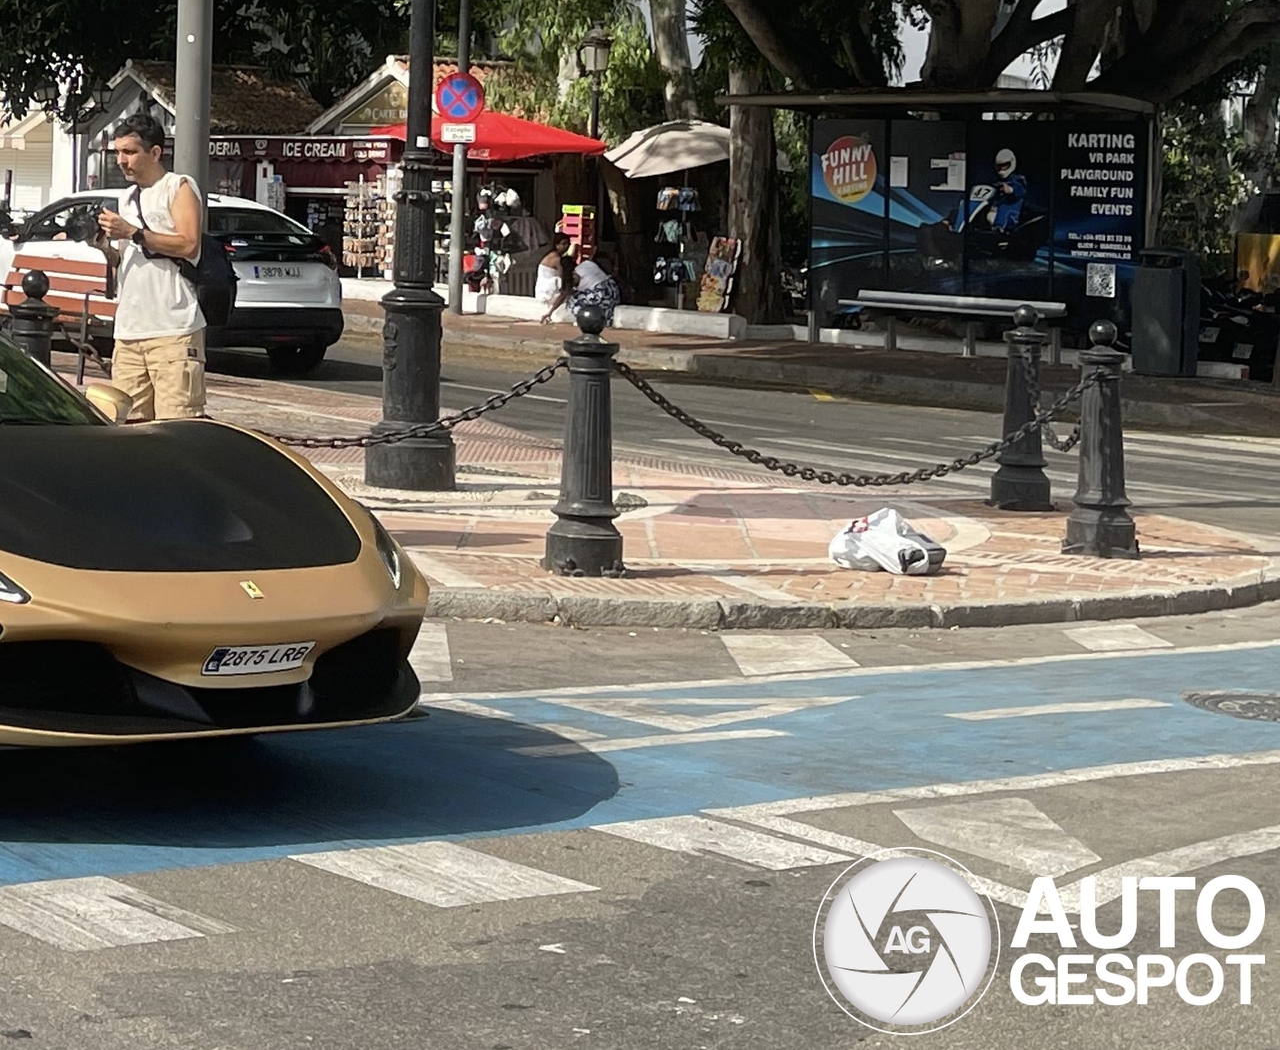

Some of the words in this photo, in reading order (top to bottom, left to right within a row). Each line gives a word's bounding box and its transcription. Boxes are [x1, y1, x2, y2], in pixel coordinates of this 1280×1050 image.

[1068, 133, 1135, 148] KARTING
[282, 142, 302, 157] ICE
[304, 142, 346, 157] CREAM
[821, 144, 872, 172] FUNNY
[1089, 152, 1104, 163] VR
[1106, 153, 1135, 164] PARK
[833, 162, 867, 186] HILL
[1061, 168, 1134, 181] PLAYGROUND
[1070, 185, 1109, 198] FAMILY
[1110, 187, 1133, 198] FUN
[1091, 203, 1133, 216] EVENTS
[221, 650, 268, 667] 2875
